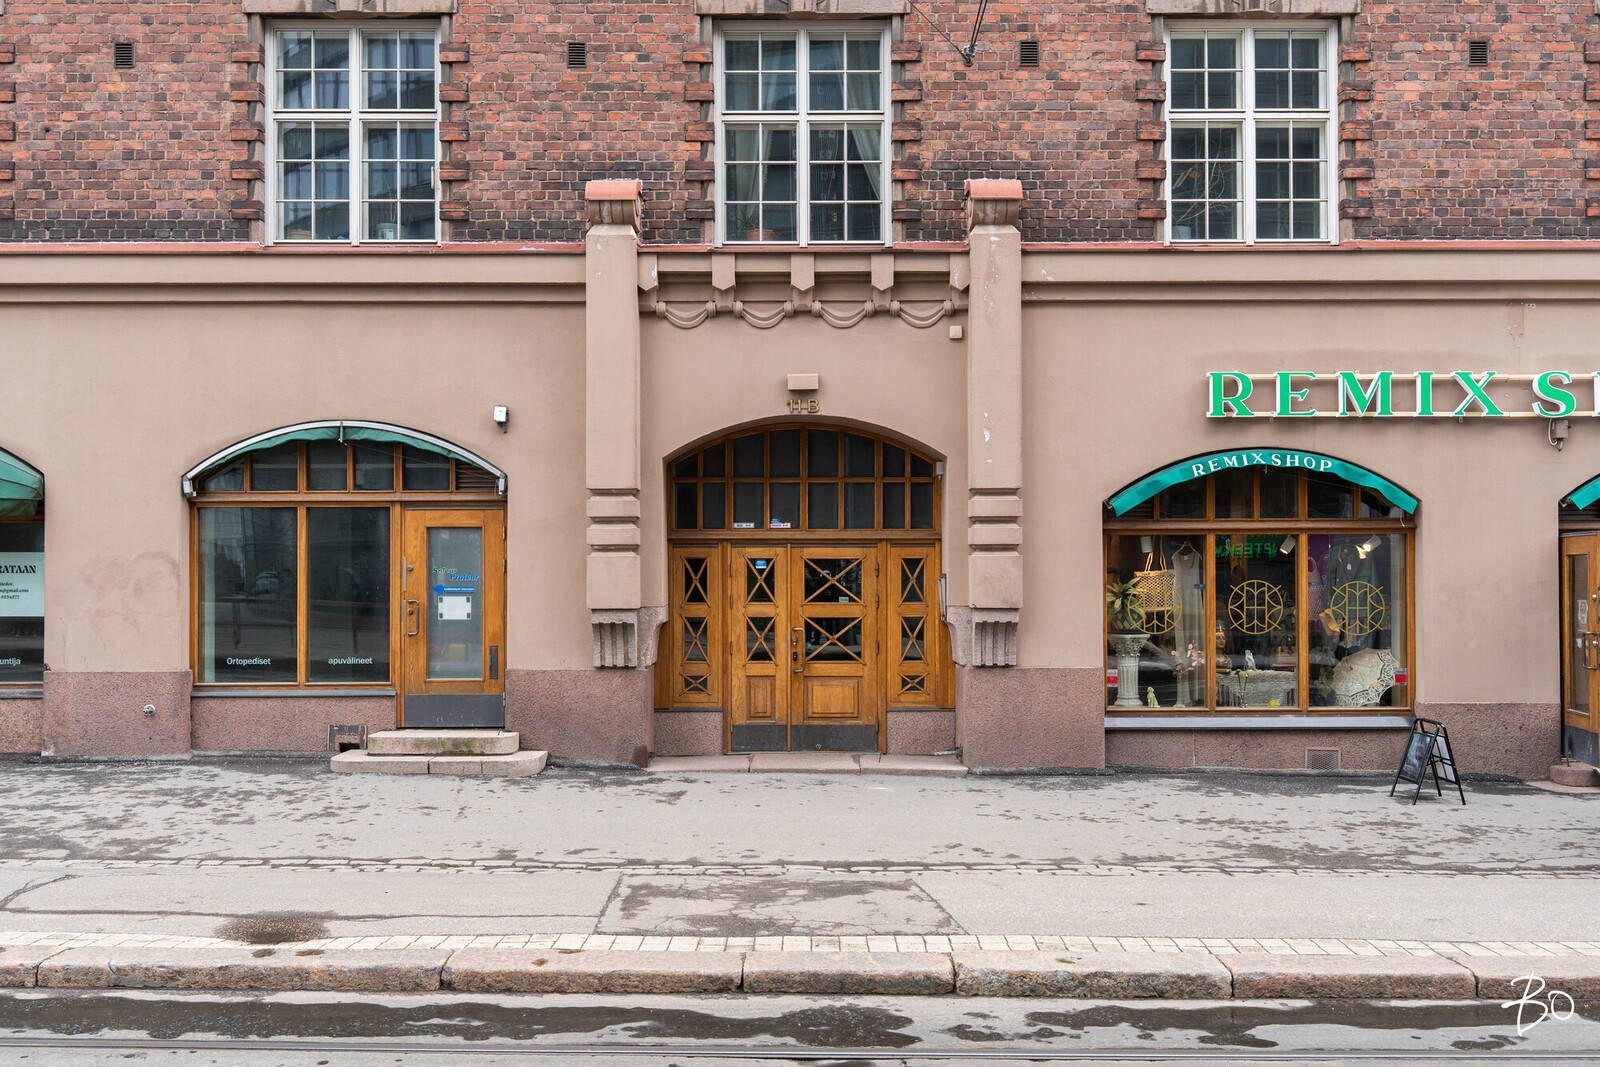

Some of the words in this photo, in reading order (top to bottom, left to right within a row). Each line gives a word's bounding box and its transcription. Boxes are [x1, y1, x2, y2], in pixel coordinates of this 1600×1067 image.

[1206, 371, 1505, 419] REMIX
[1531, 371, 1600, 419] S
[787, 398, 802, 414] 11
[807, 398, 820, 414] B
[449, 573, 480, 581] Proteor
[226, 657, 271, 667] Ortopediset
[328, 656, 373, 666] apuvälineet
